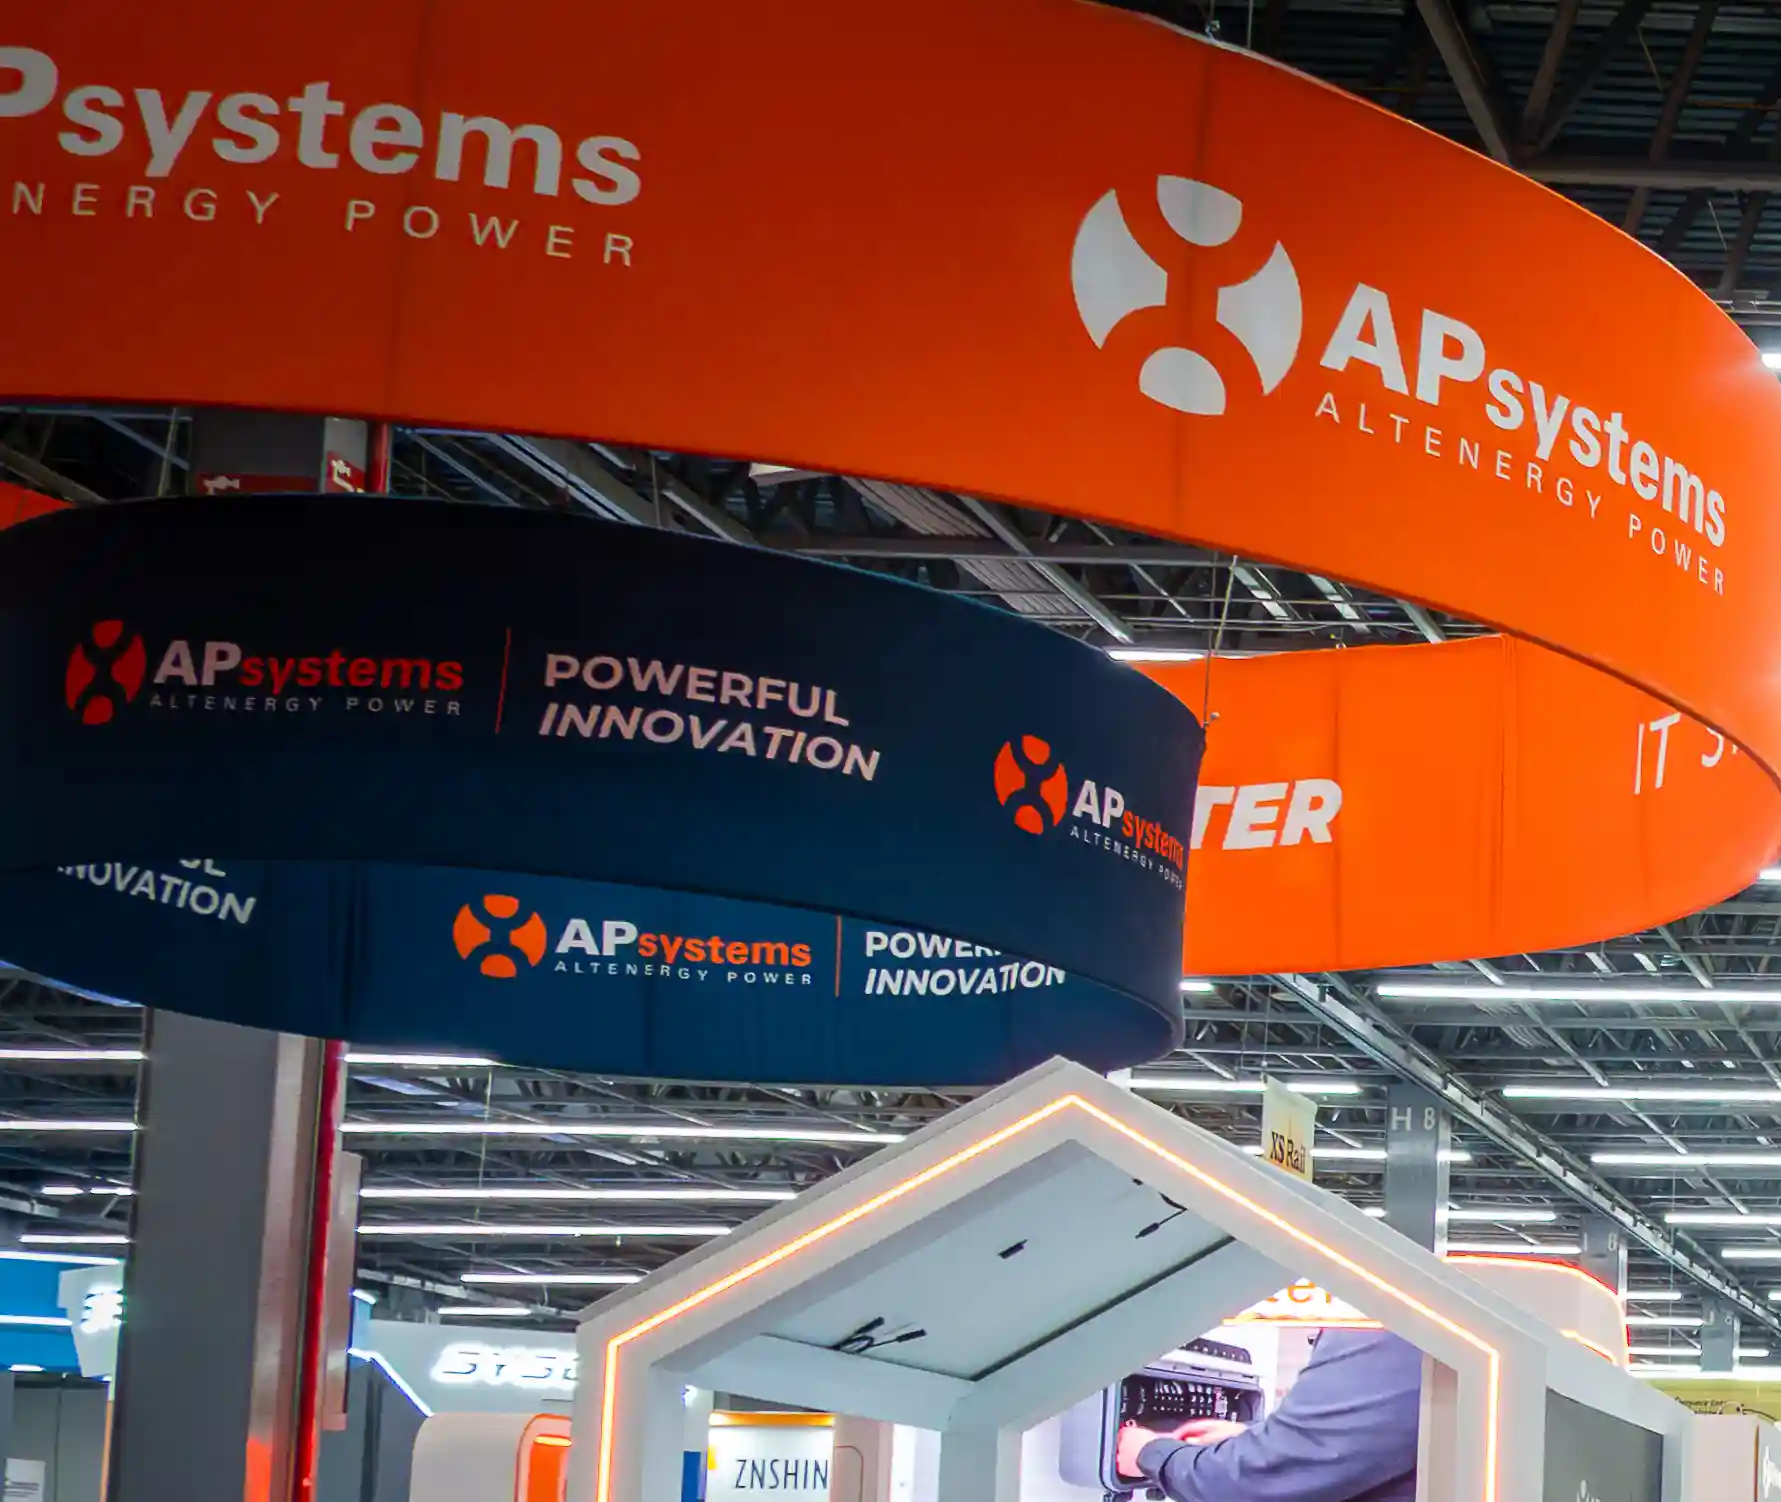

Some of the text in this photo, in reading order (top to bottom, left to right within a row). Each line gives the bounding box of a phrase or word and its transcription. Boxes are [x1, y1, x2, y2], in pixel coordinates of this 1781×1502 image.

[345, 200, 636, 267] POWER
[1319, 282, 1727, 549] APsystems
[1314, 392, 1726, 597] ALTENERGY POWER
[153, 640, 464, 690] APsystems
[543, 652, 851, 728] POWERFUL
[149, 694, 463, 716] ALTENERGY POWER
[537, 702, 883, 781] INNOVATION
[554, 918, 812, 968] APsystems
[554, 960, 813, 986] ALTENERGY POWER
[863, 960, 1067, 996] INNOVATION
[1286, 1137, 1307, 1174] Rail
